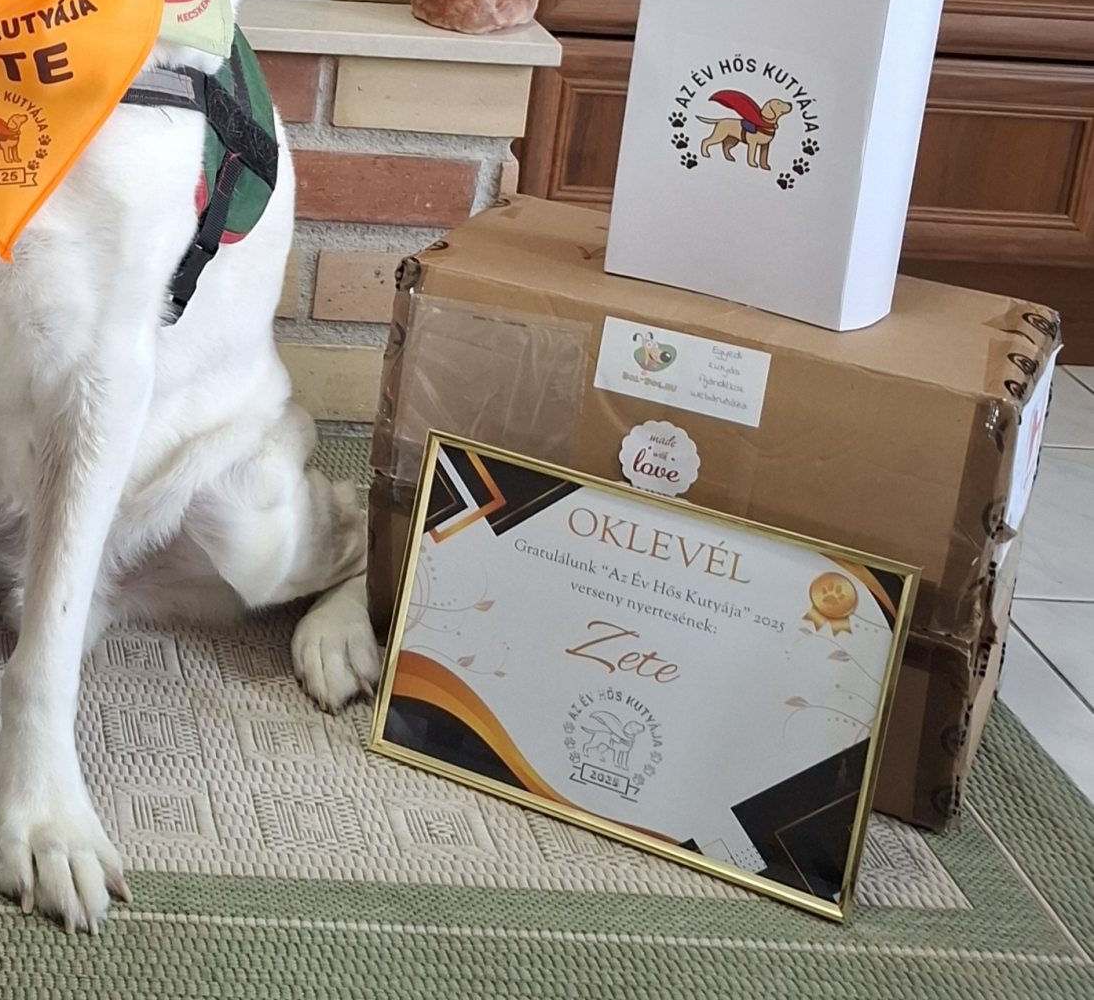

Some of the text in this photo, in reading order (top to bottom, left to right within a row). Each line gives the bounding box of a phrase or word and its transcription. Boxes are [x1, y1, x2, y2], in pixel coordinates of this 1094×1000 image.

[3, 90, 49, 132] KUTYÁJA
[675, 85, 696, 109] AZ
[690, 65, 714, 87] ÉV
[762, 62, 820, 132] KUTYÁJA
[632, 448, 680, 483] love
[649, 433, 677, 448] made
[567, 506, 752, 584] OKLEVÉL
[514, 537, 597, 575] Gratulálunk
[631, 570, 650, 590] Év
[652, 580, 682, 600] Hős
[753, 613, 786, 634] 2025
[570, 580, 718, 635] verseny nyertesének:
[564, 620, 681, 684] Zete
[568, 704, 582, 721] AZ
[625, 695, 663, 747] KUTYÁJA
[589, 769, 620, 788] 2025
